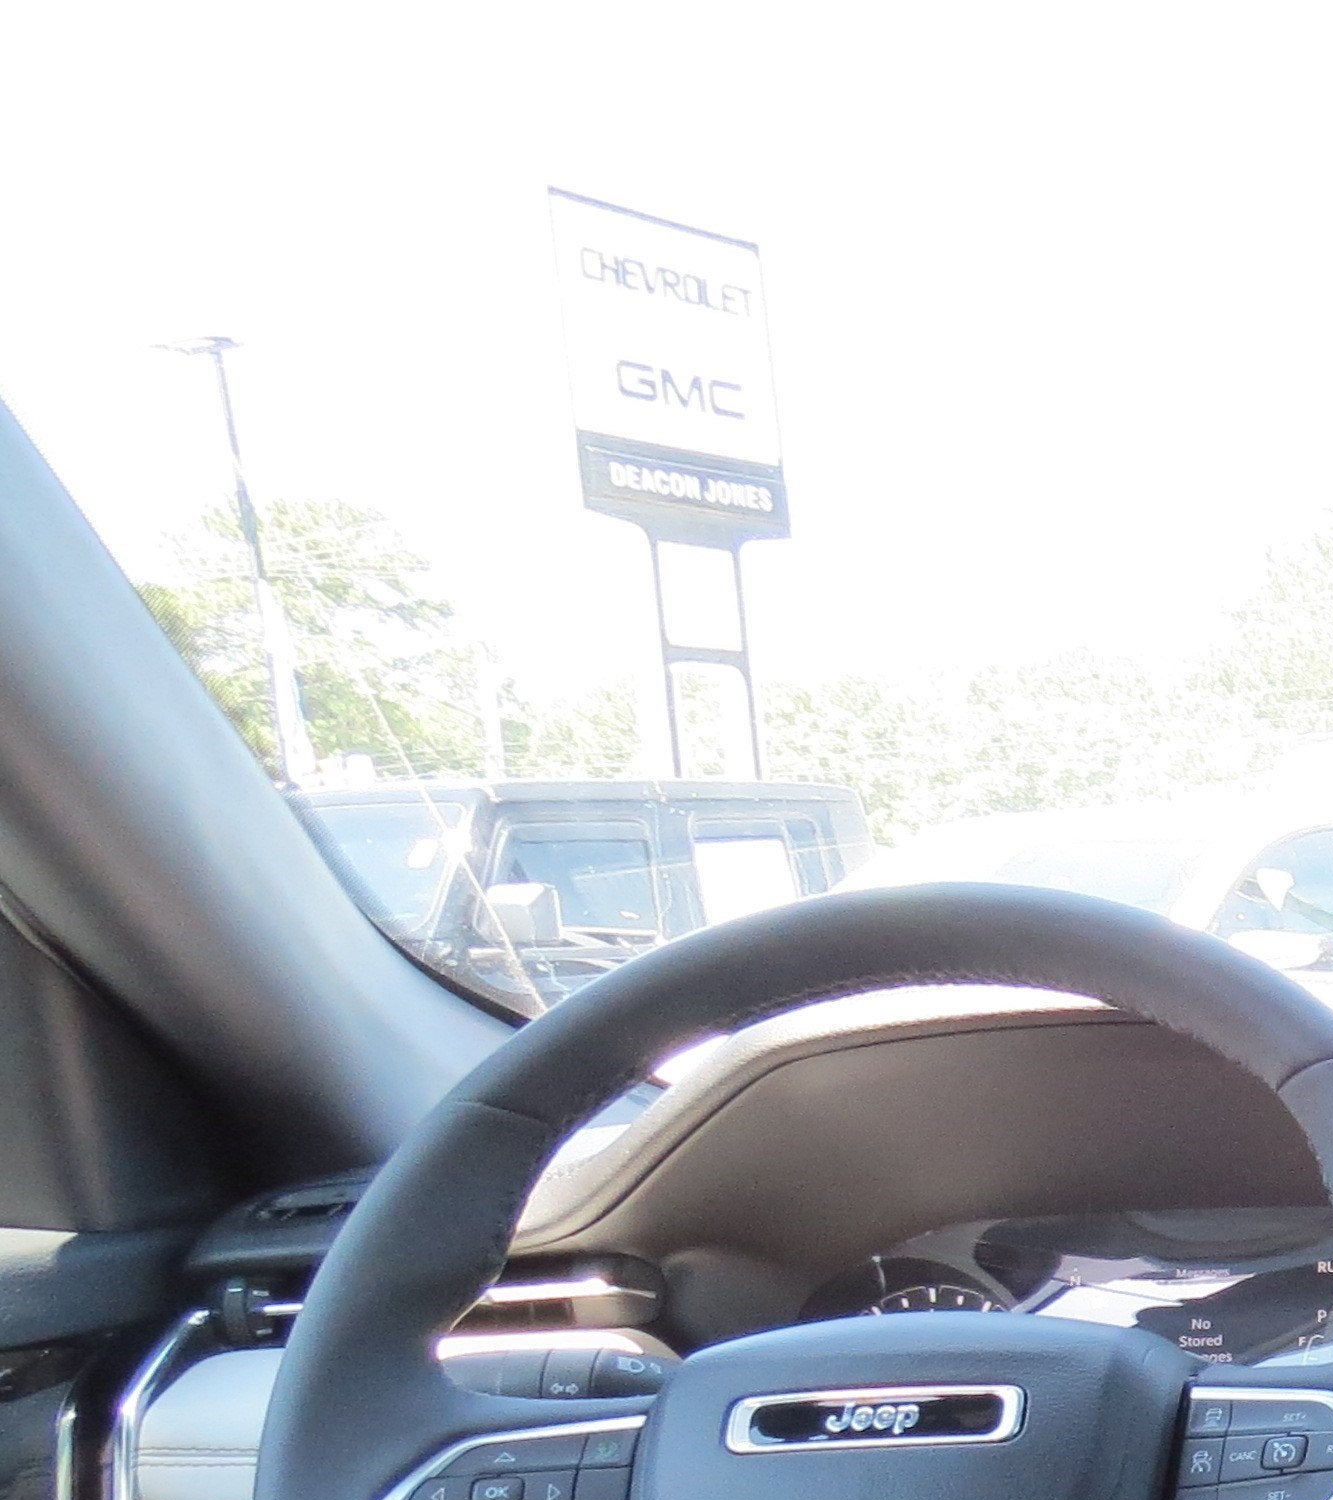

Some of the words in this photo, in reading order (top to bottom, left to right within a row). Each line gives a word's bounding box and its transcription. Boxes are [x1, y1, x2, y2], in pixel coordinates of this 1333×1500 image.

[580, 246, 752, 317] CHEVROLET
[616, 360, 745, 420] GMC
[608, 461, 701, 501] DEACON
[703, 477, 774, 513] JONES
[1317, 1309, 1327, 1323] P
[1191, 1318, 1212, 1331] No
[1178, 1334, 1223, 1348] Stored
[1298, 1336, 1306, 1347] F
[825, 1401, 921, 1435] Jeep
[485, 1485, 509, 1500] OK
